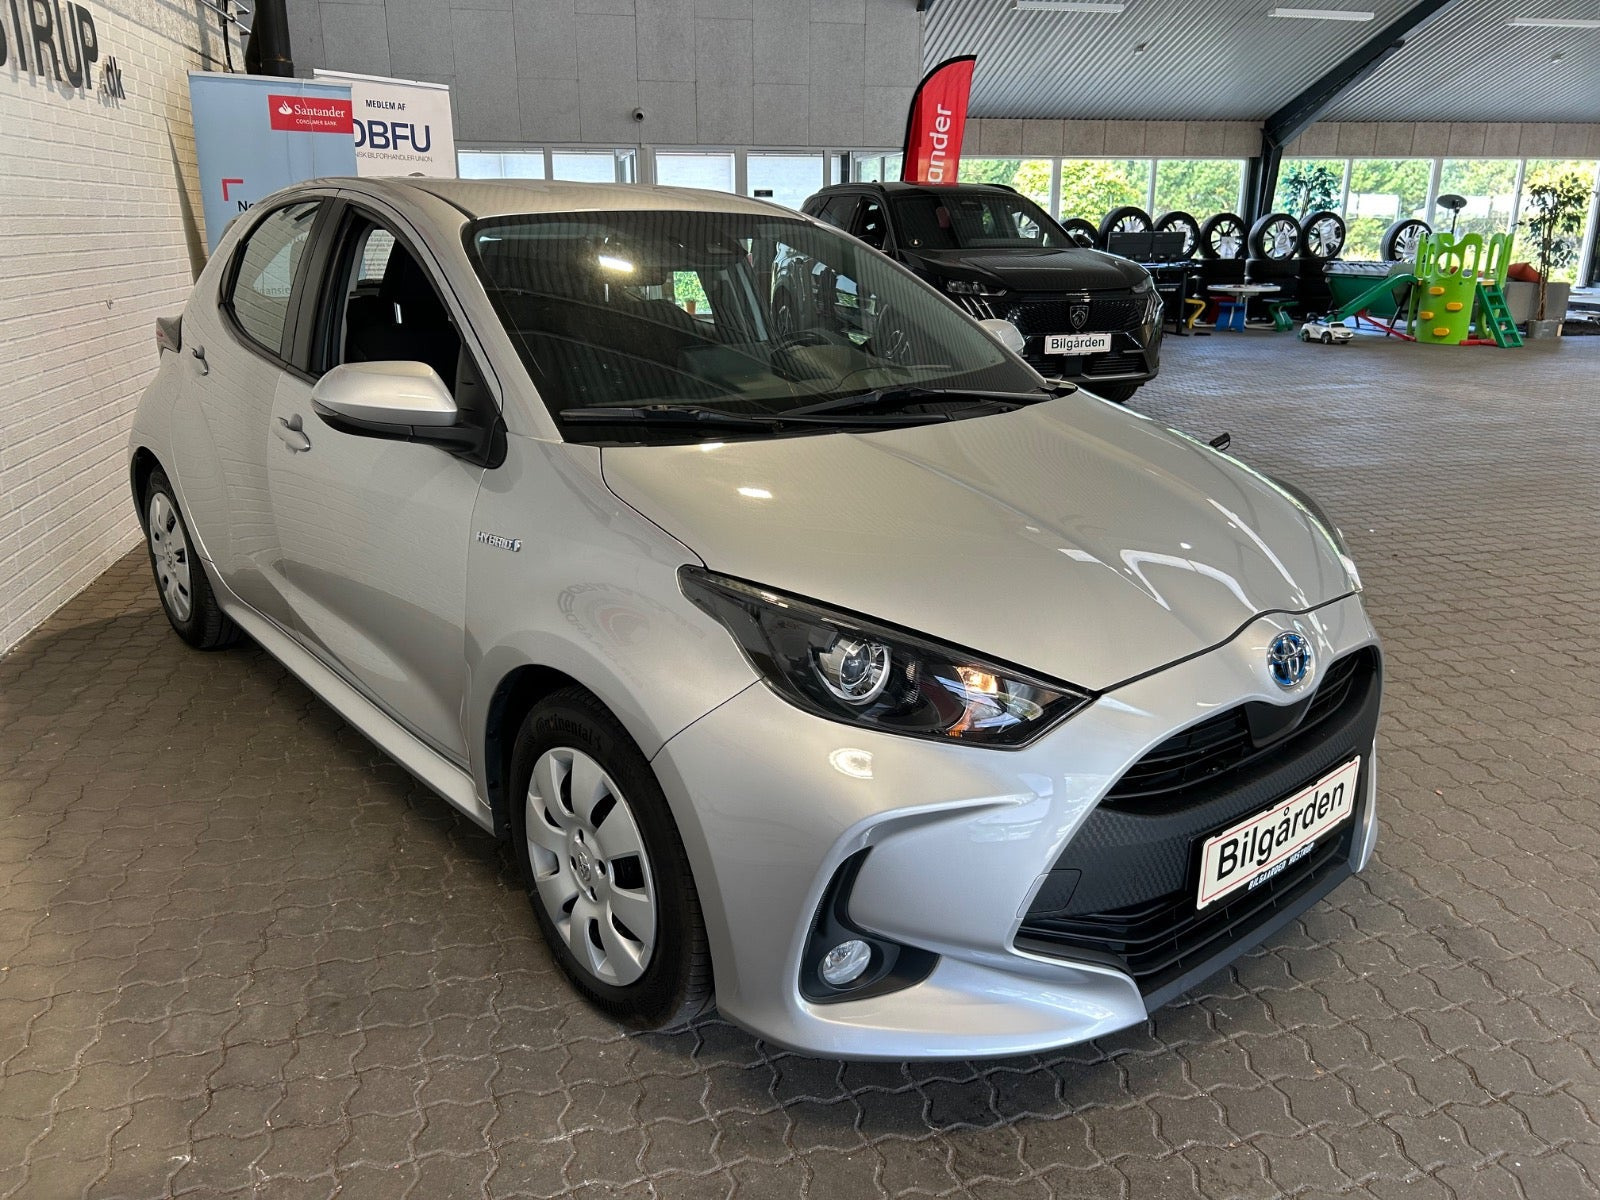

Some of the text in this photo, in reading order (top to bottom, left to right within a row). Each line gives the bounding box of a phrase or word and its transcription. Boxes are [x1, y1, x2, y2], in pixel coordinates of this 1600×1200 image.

[294, 104, 345, 118] Santander
[365, 99, 407, 111] MEDLEM AF
[296, 118, 324, 126] CONSUMER
[1051, 336, 1105, 351] Bilgården
[1216, 781, 1345, 882] Bilgården
